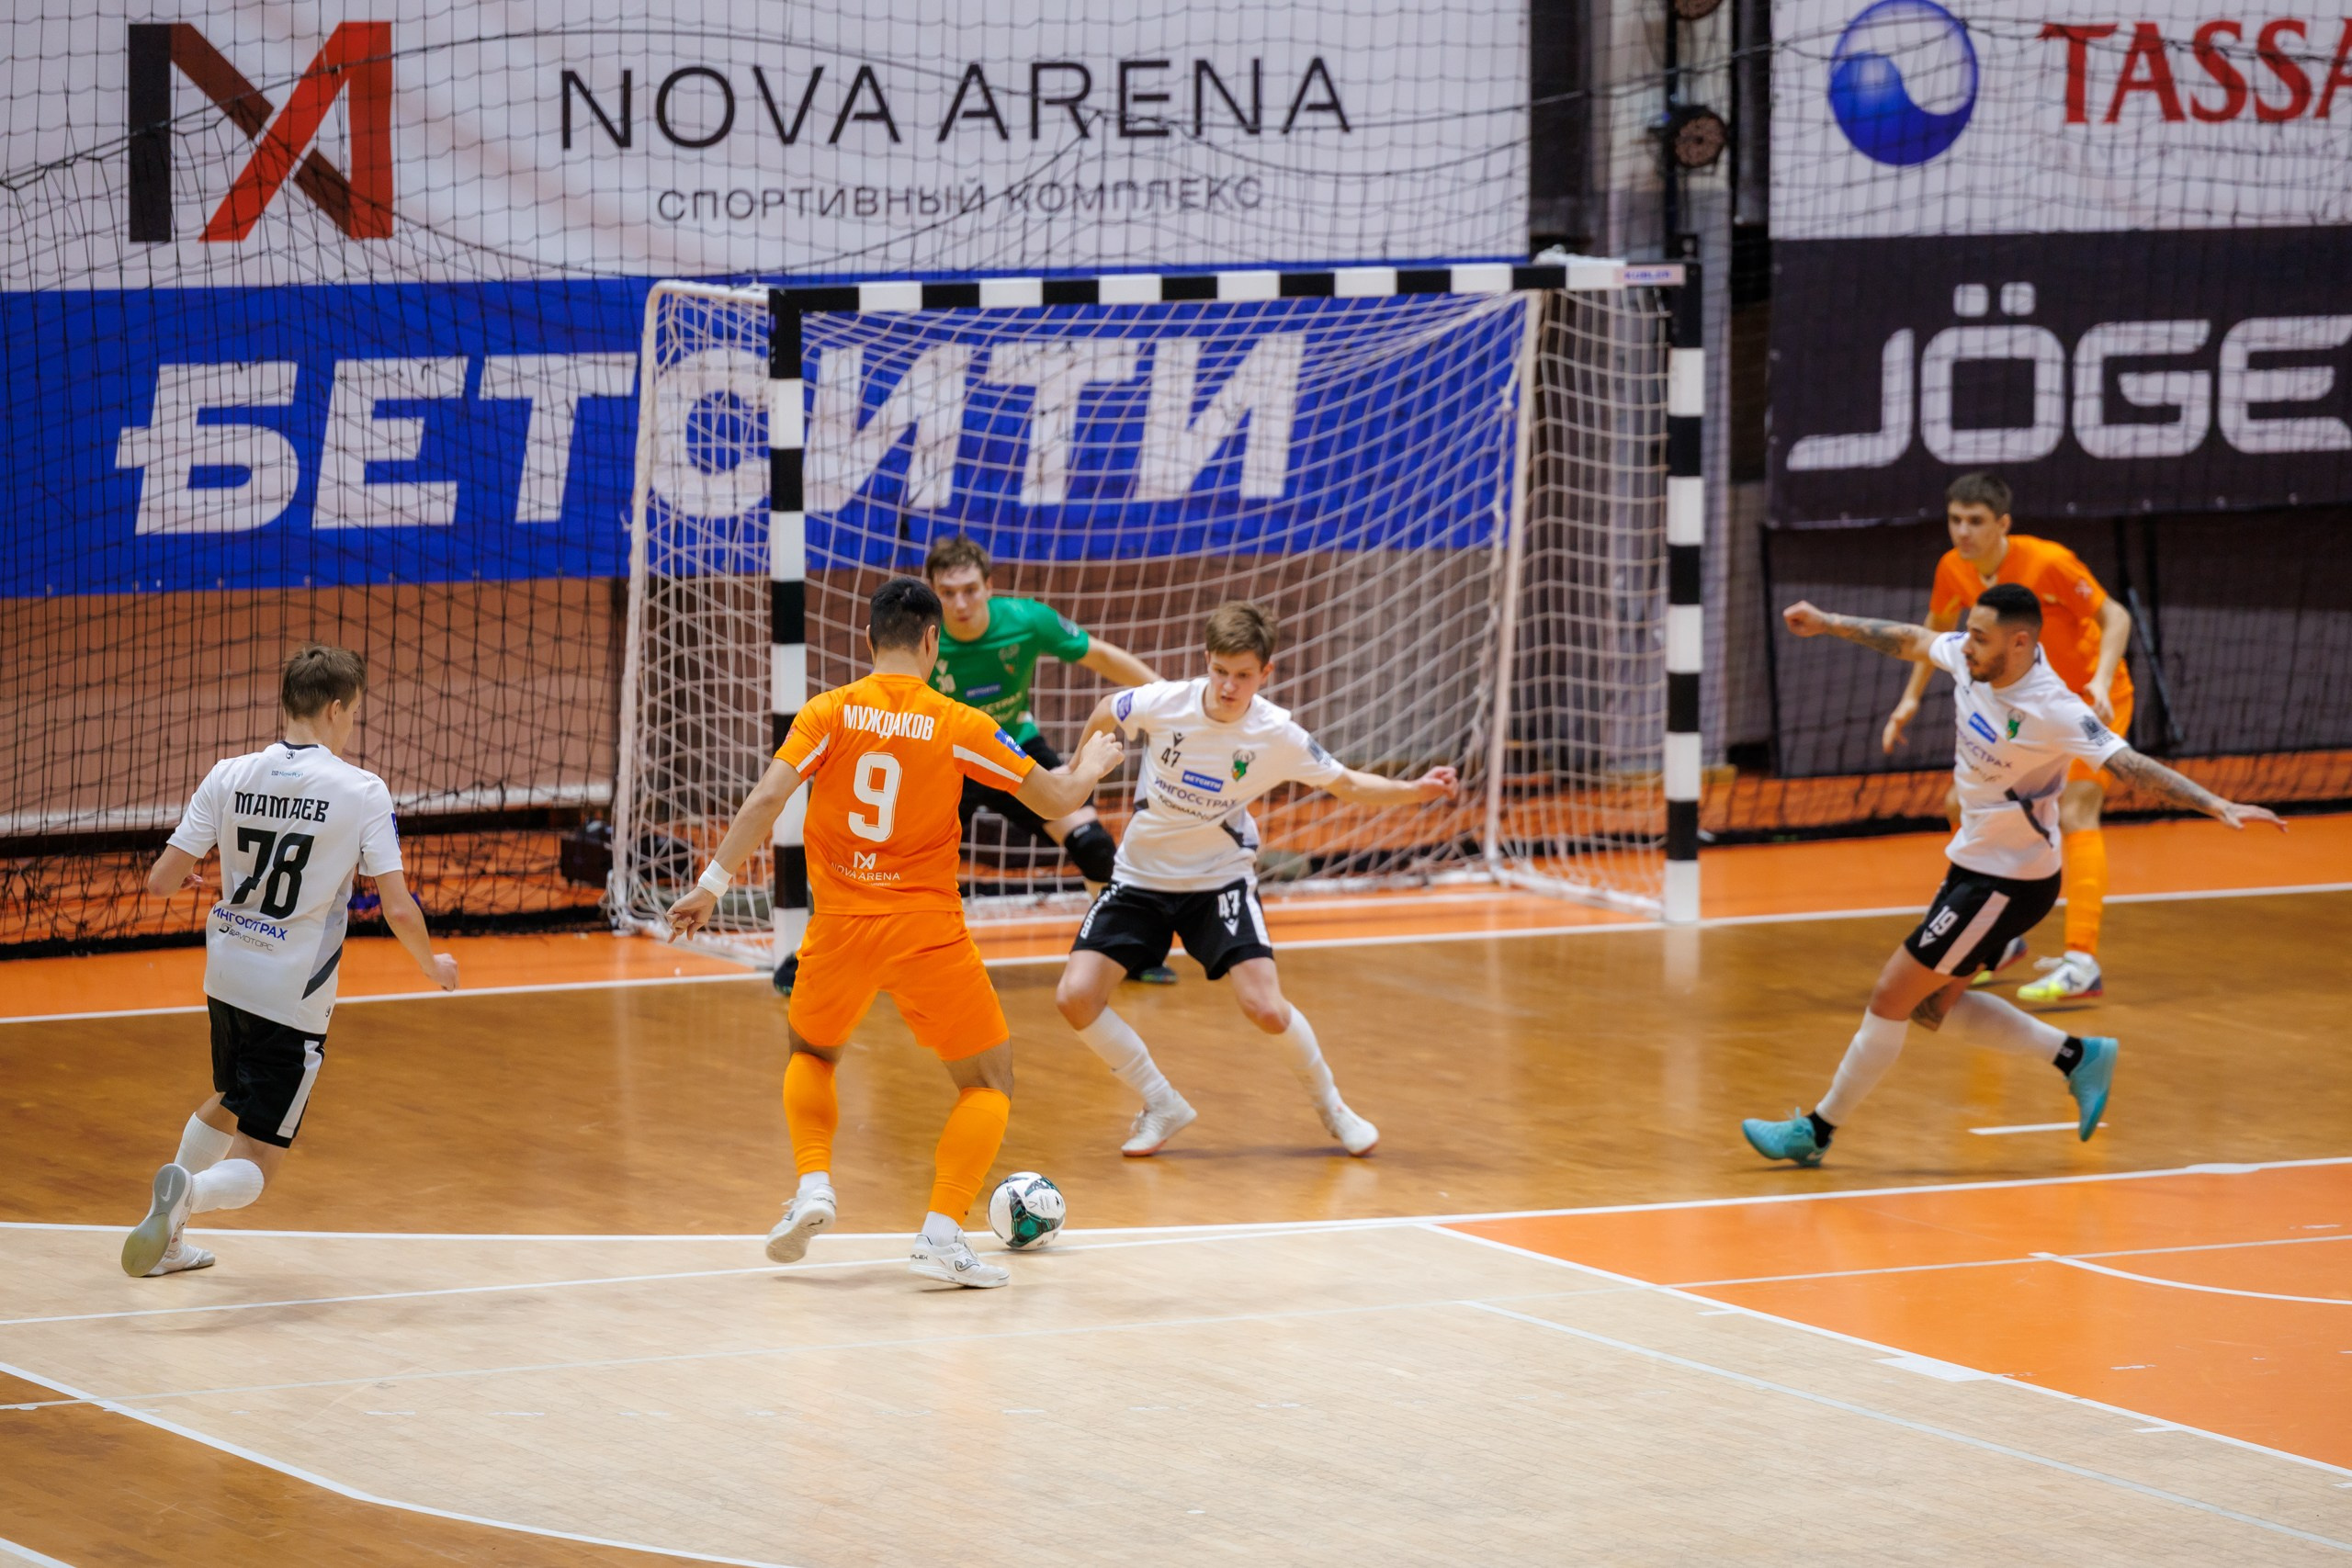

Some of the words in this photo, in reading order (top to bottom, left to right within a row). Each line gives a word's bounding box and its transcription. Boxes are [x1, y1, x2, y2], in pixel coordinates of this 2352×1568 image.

[561, 64, 902, 151] NOVA
[936, 56, 1351, 142] ARENA
[658, 175, 986, 221] СПОРТИВНЫЙ
[1007, 175, 1262, 215] КОМПЛЕКС
[1786, 282, 2352, 471] JÖGE
[115, 331, 1306, 536] БЕТСИТИ
[843, 704, 935, 741] МУЖДАКОВ
[1160, 747, 1182, 768] 47
[234, 791, 330, 823] МАМАЕВ
[847, 751, 903, 842] 9
[1155, 776, 1237, 808] ИНГОССТРАХ
[230, 826, 315, 919] 78
[831, 862, 856, 879] NOVA
[858, 872, 900, 881] ARENA
[1217, 889, 1241, 919] 47
[1928, 905, 1960, 937] 19
[212, 905, 288, 941] ИНГОСТРАХ
